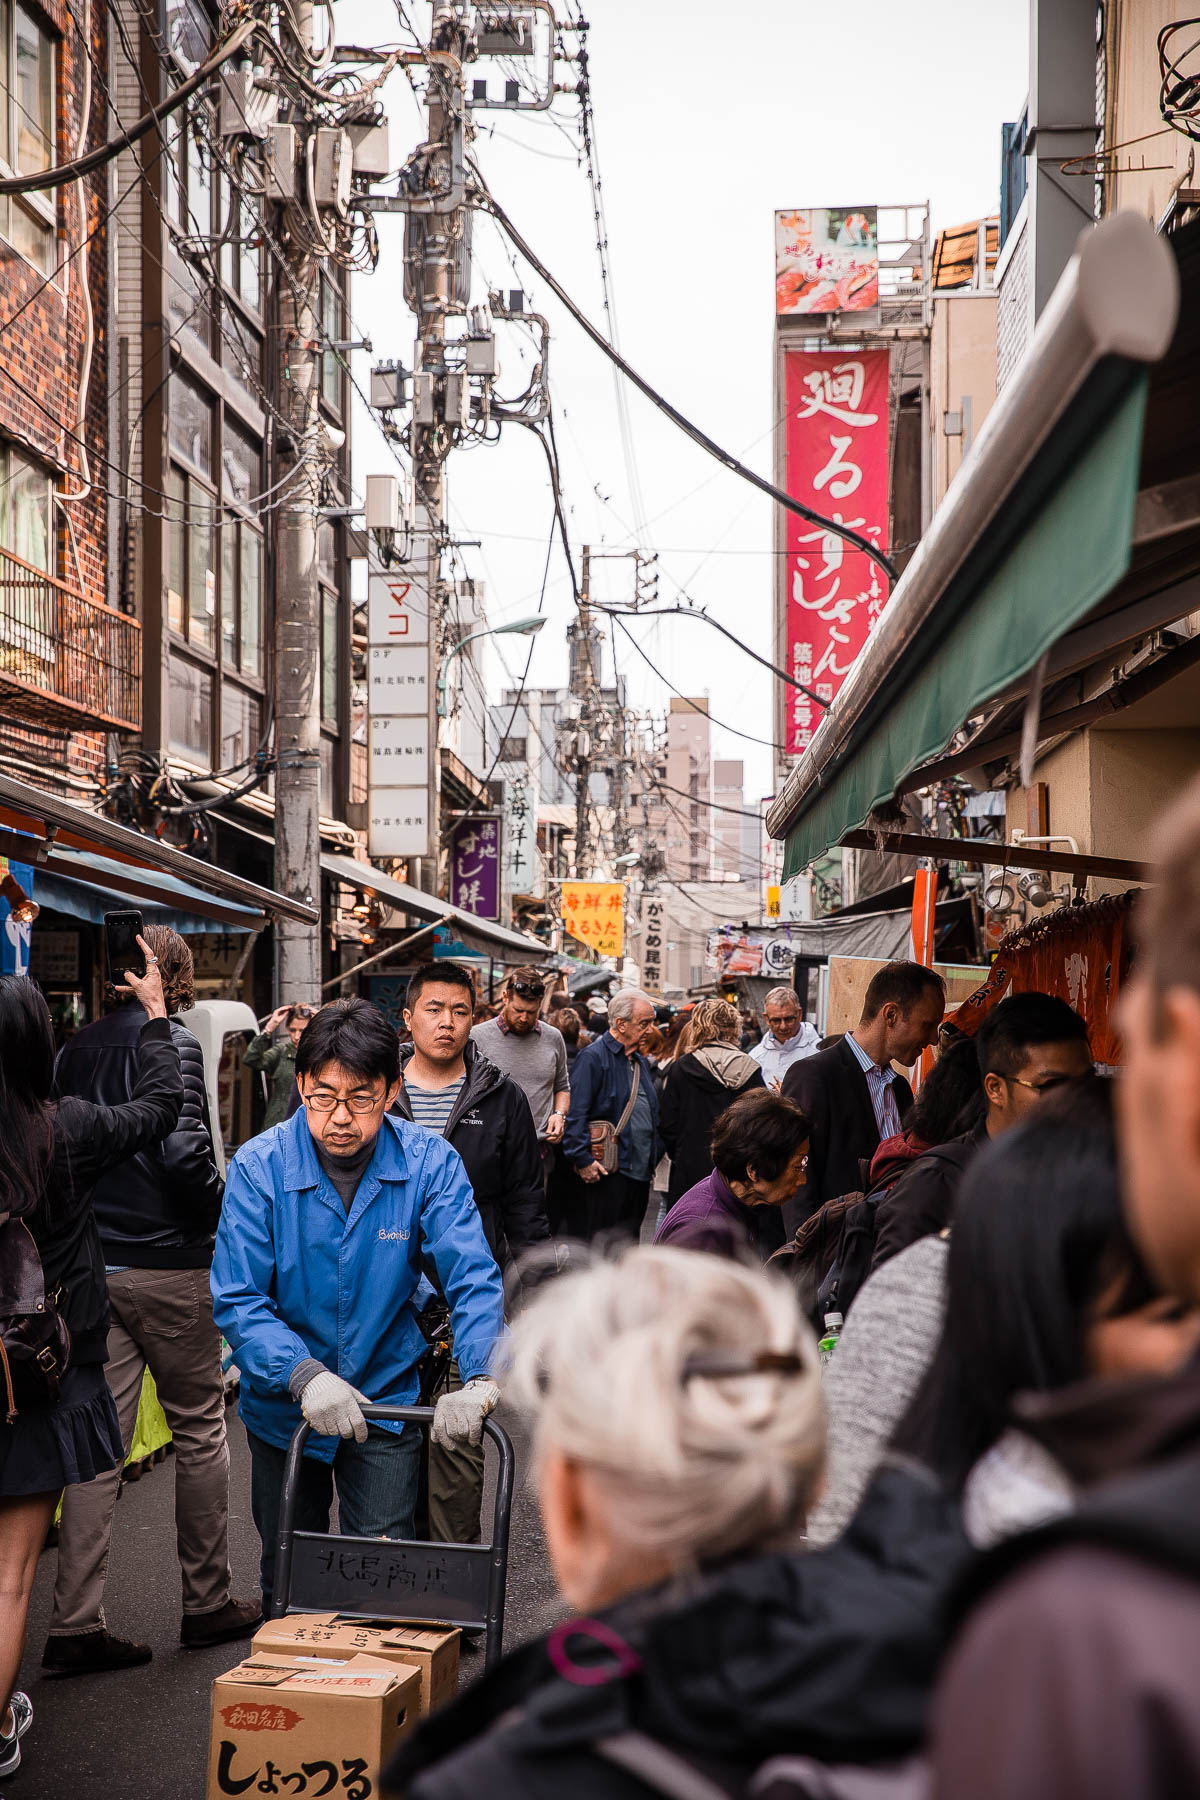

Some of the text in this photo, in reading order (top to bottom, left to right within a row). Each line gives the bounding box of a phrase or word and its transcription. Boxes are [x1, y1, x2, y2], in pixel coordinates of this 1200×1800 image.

[229, 1706, 289, 1730] 秋田名産
[217, 1740, 372, 1800] しょっつる
